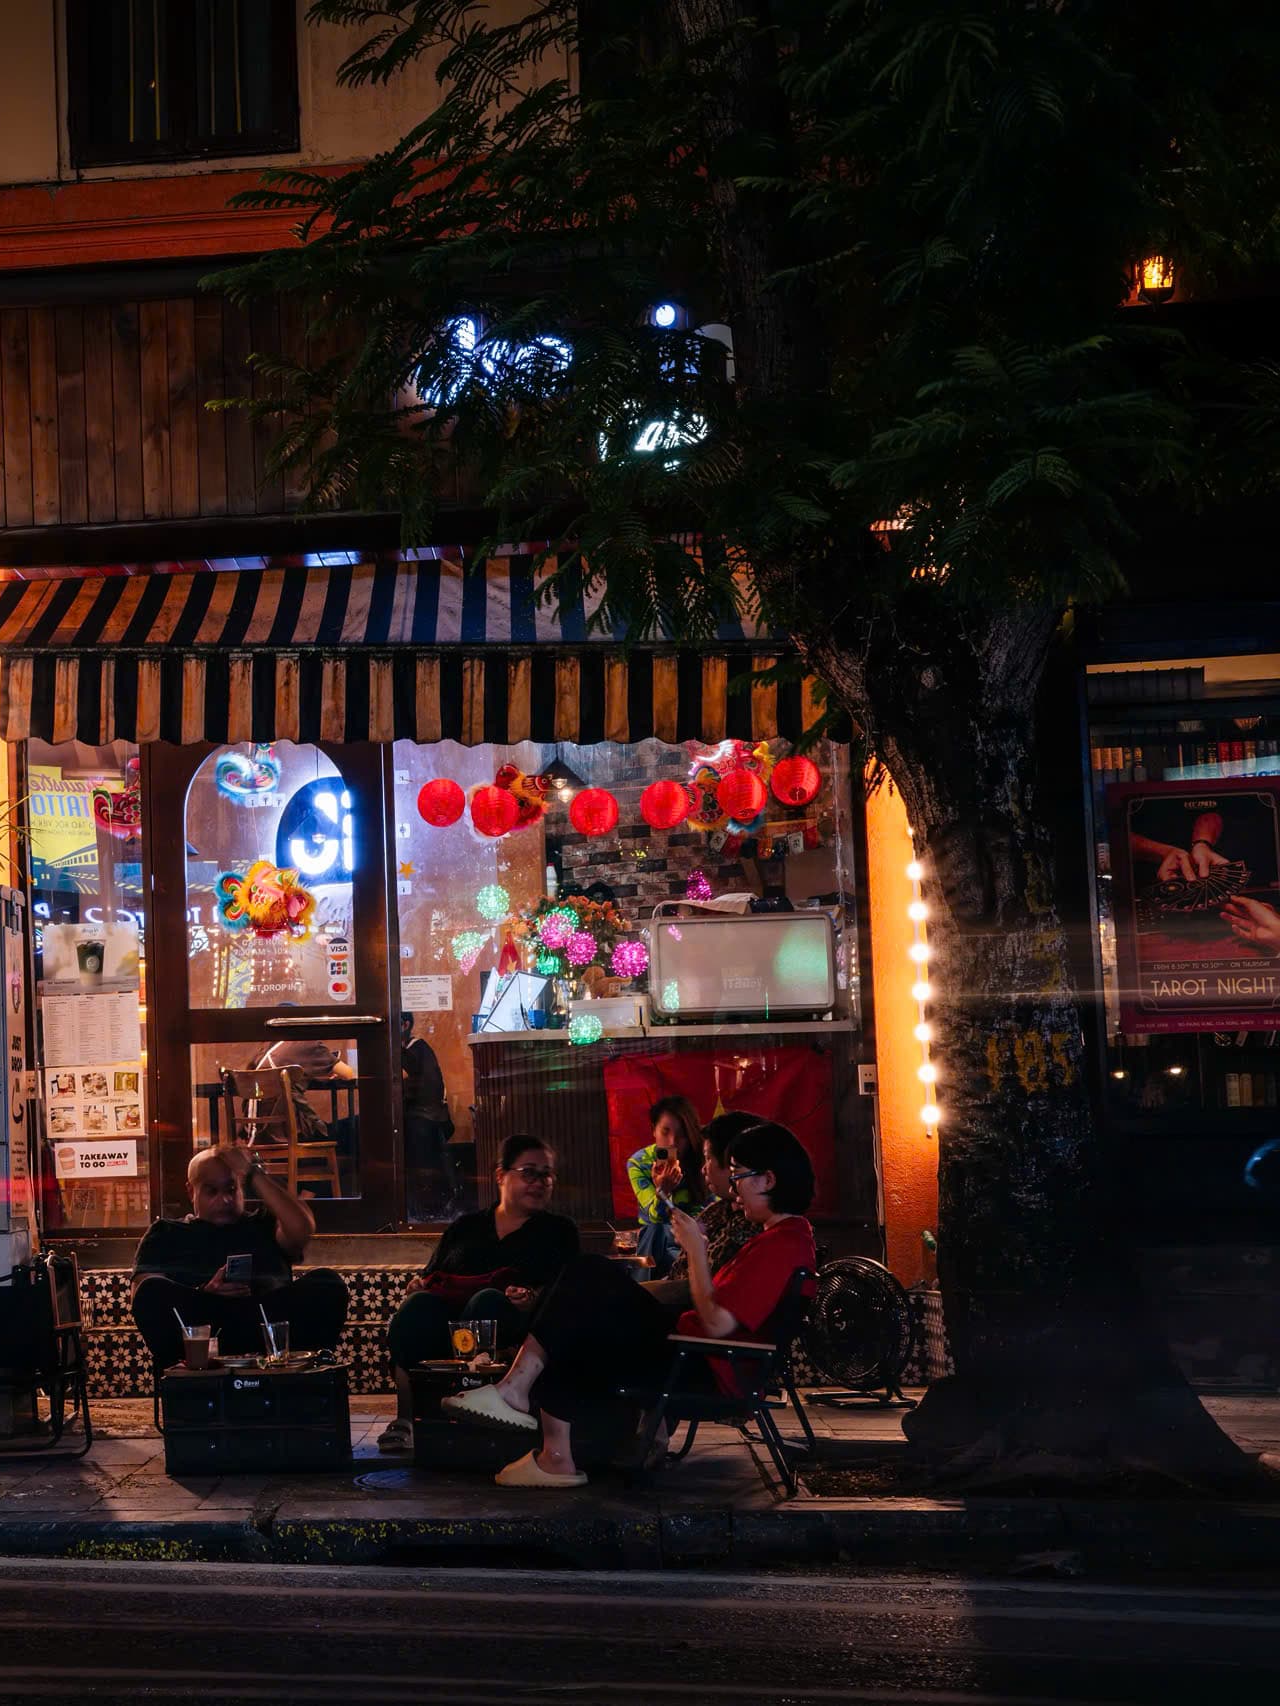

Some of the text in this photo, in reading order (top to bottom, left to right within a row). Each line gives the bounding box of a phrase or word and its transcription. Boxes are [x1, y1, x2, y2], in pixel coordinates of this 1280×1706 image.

[330, 945, 348, 953] VISA
[1150, 976, 1276, 997] TAROT NIGHT
[80, 1152, 129, 1161] TAKEAWAY
